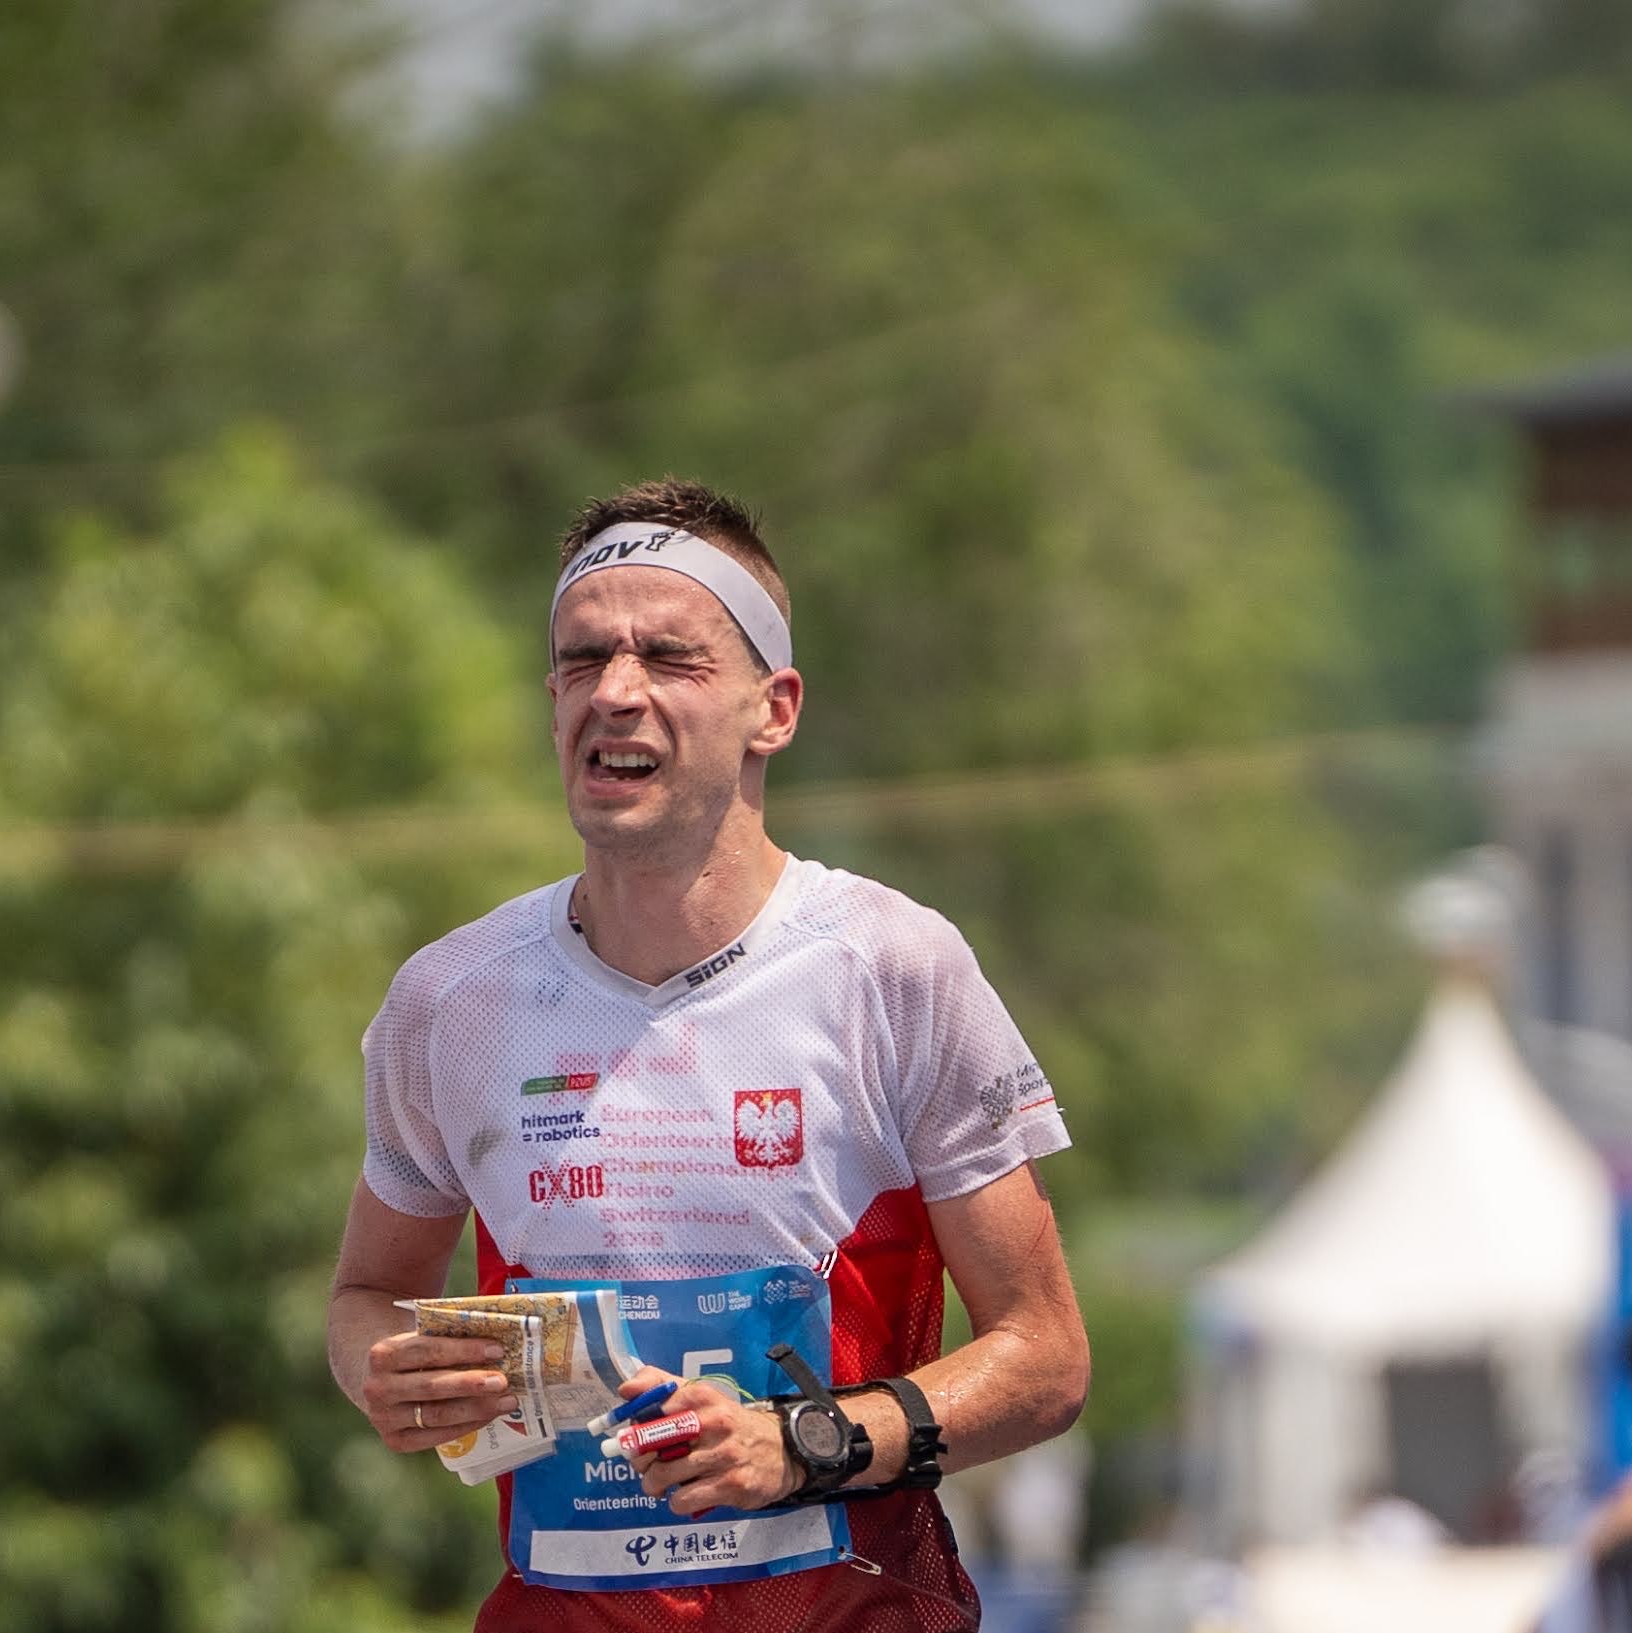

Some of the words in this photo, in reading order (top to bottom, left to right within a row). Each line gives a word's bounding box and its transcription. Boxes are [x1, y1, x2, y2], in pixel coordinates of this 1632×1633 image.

[521, 1110, 586, 1129] hitmark
[536, 1125, 601, 1143] robotics
[573, 1494, 658, 1512] Orienteering
[663, 1529, 738, 1557] 中国电信
[665, 1555, 694, 1564] CHINA
[696, 1551, 739, 1562] TELECOM
